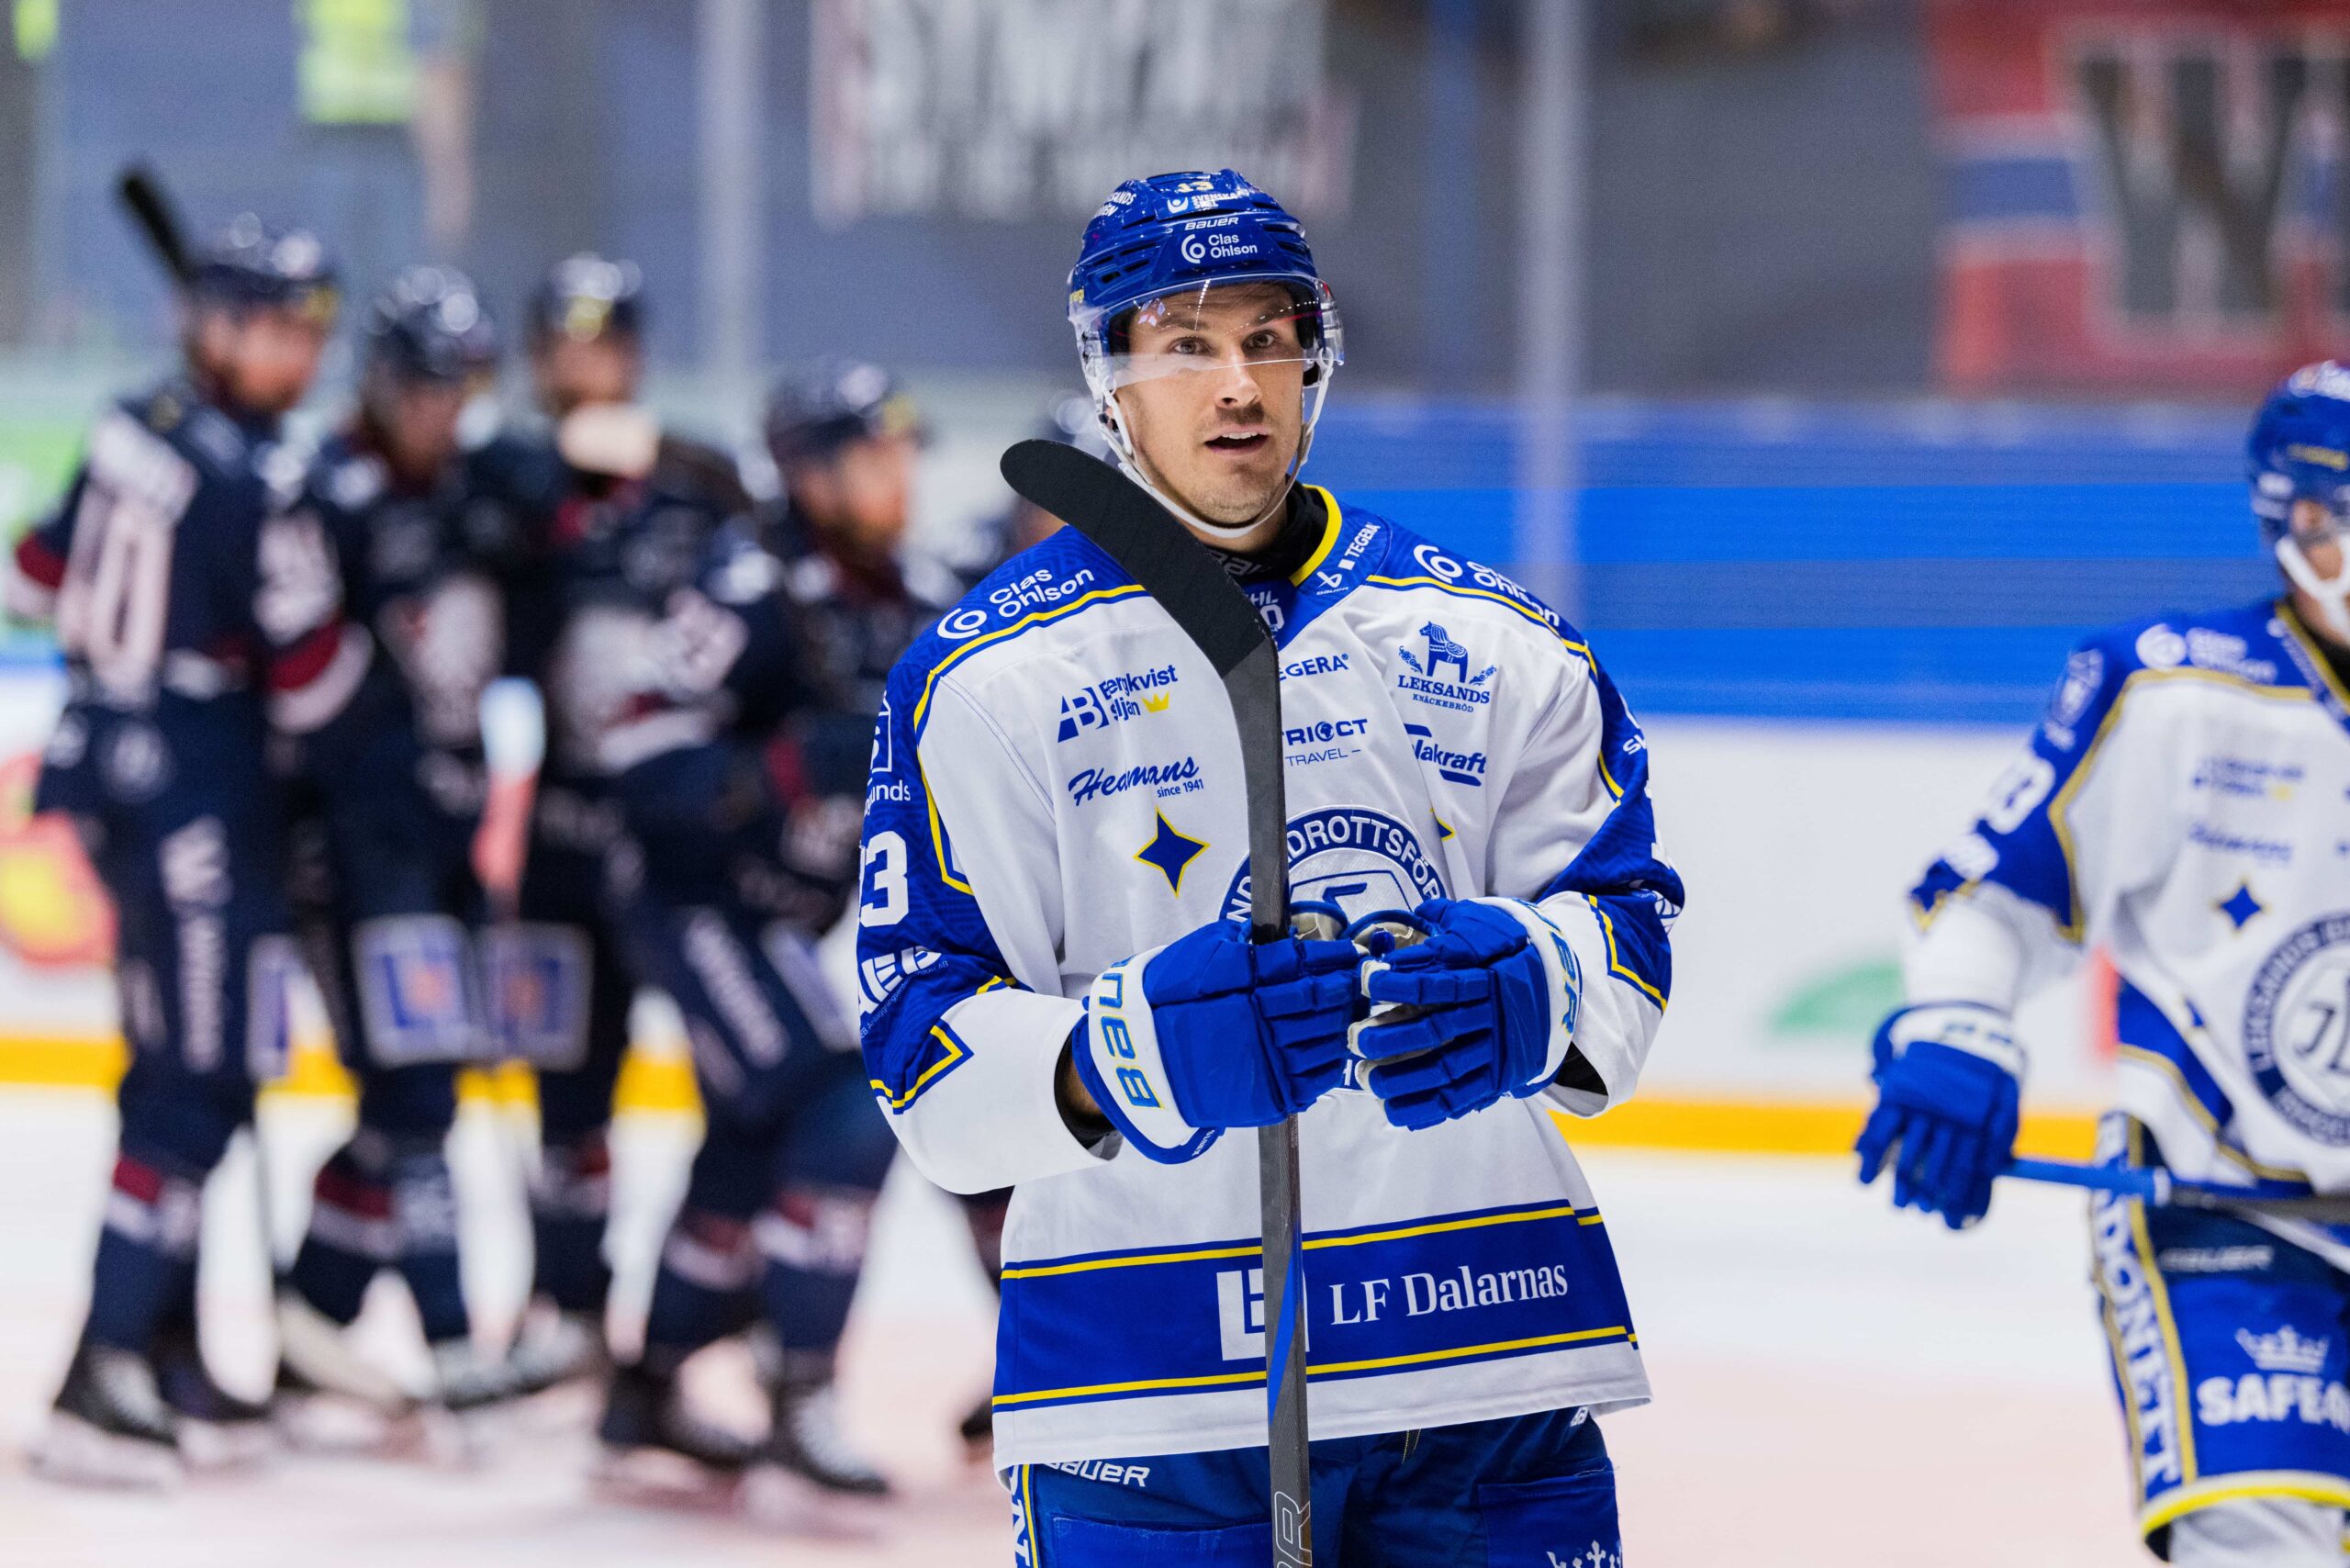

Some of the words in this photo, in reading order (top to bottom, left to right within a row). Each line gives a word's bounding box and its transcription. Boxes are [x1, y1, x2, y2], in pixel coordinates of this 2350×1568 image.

[1184, 217, 1239, 230] BAUER
[1208, 233, 1240, 246] Clas
[1210, 244, 1259, 259] Ohlson
[989, 569, 1053, 604] Clas
[998, 568, 1095, 618] Ohlson
[1397, 674, 1491, 705] LEKSANDS
[1412, 693, 1474, 713] KNÄCKEBRÖD
[1284, 747, 1348, 767] TRAVEL
[1412, 738, 1487, 775] lakraft
[1157, 785, 1181, 799] since
[1182, 778, 1204, 793] 1941
[1286, 814, 1441, 902] DROTTSFÖR
[1328, 1277, 1393, 1327] LF
[1401, 1262, 1569, 1318] Dalarnas
[1044, 1459, 1151, 1488] AUER
